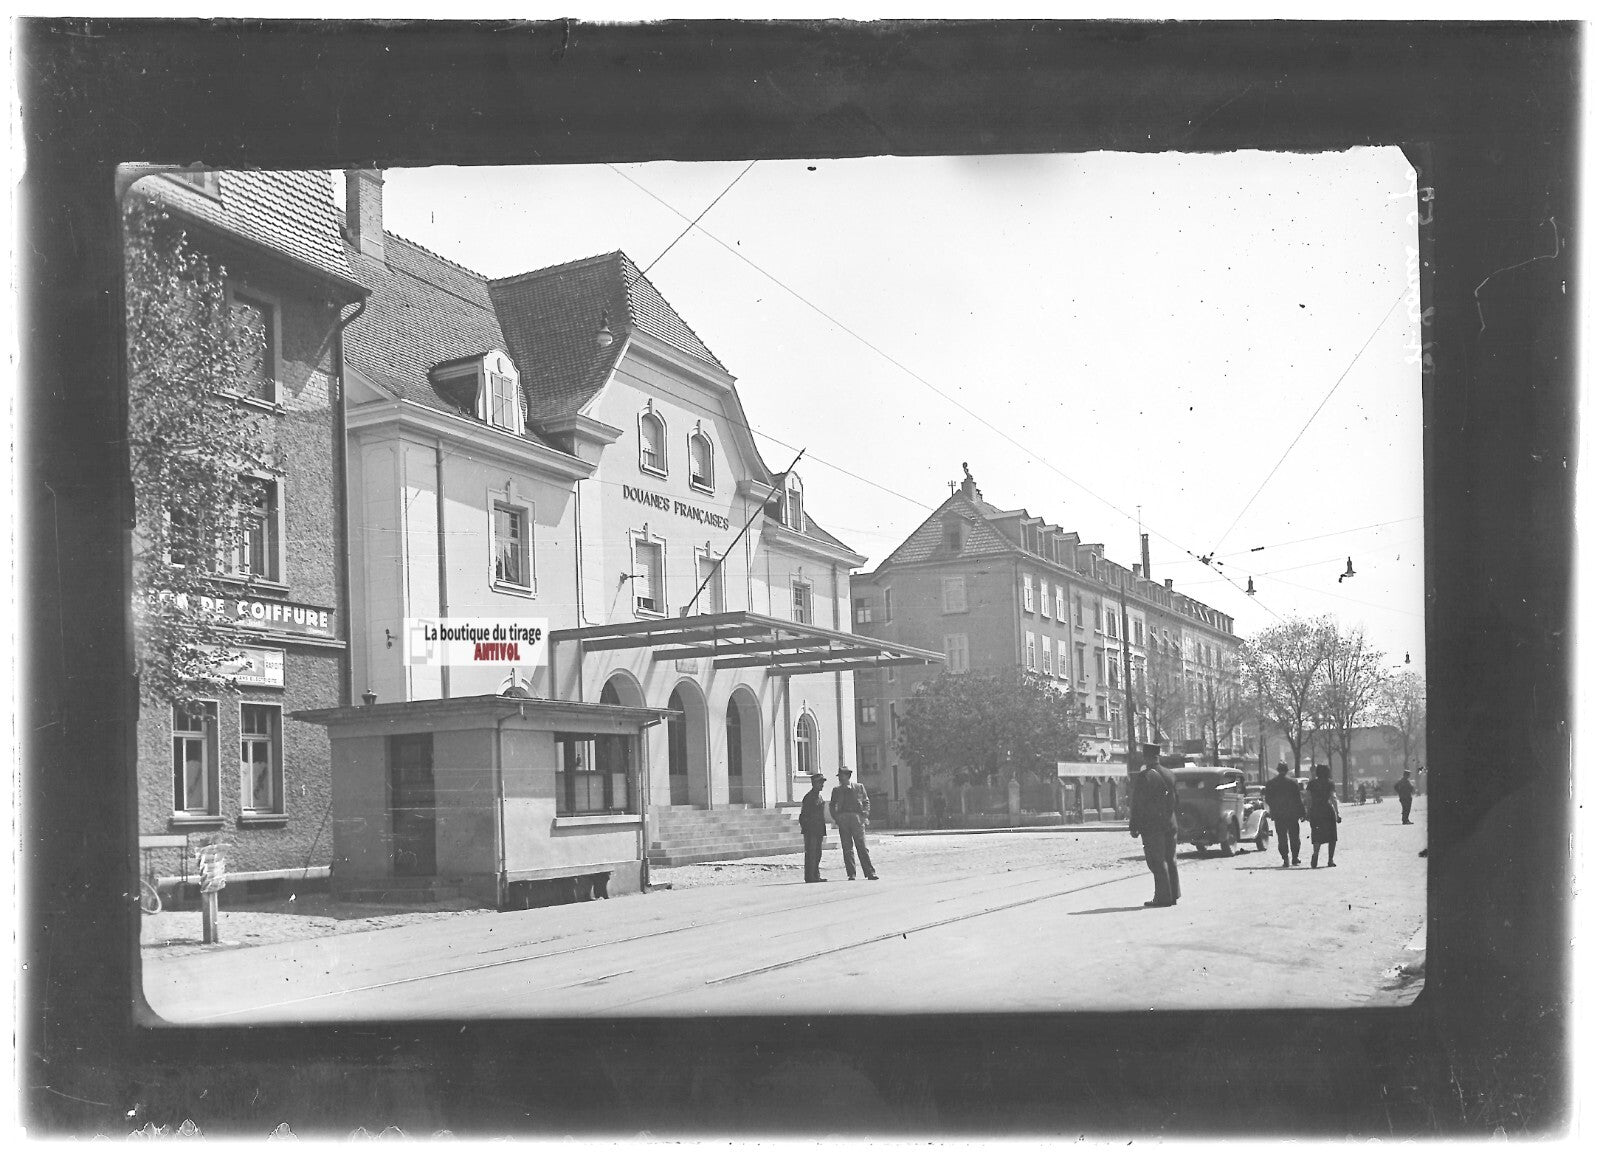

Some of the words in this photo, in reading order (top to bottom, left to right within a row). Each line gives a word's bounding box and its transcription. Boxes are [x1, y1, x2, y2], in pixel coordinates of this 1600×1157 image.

[622, 484, 670, 511] DOUANES
[674, 501, 729, 531] FRANÇAISES
[200, 596, 225, 614] DE
[236, 600, 328, 628] COIFFURE
